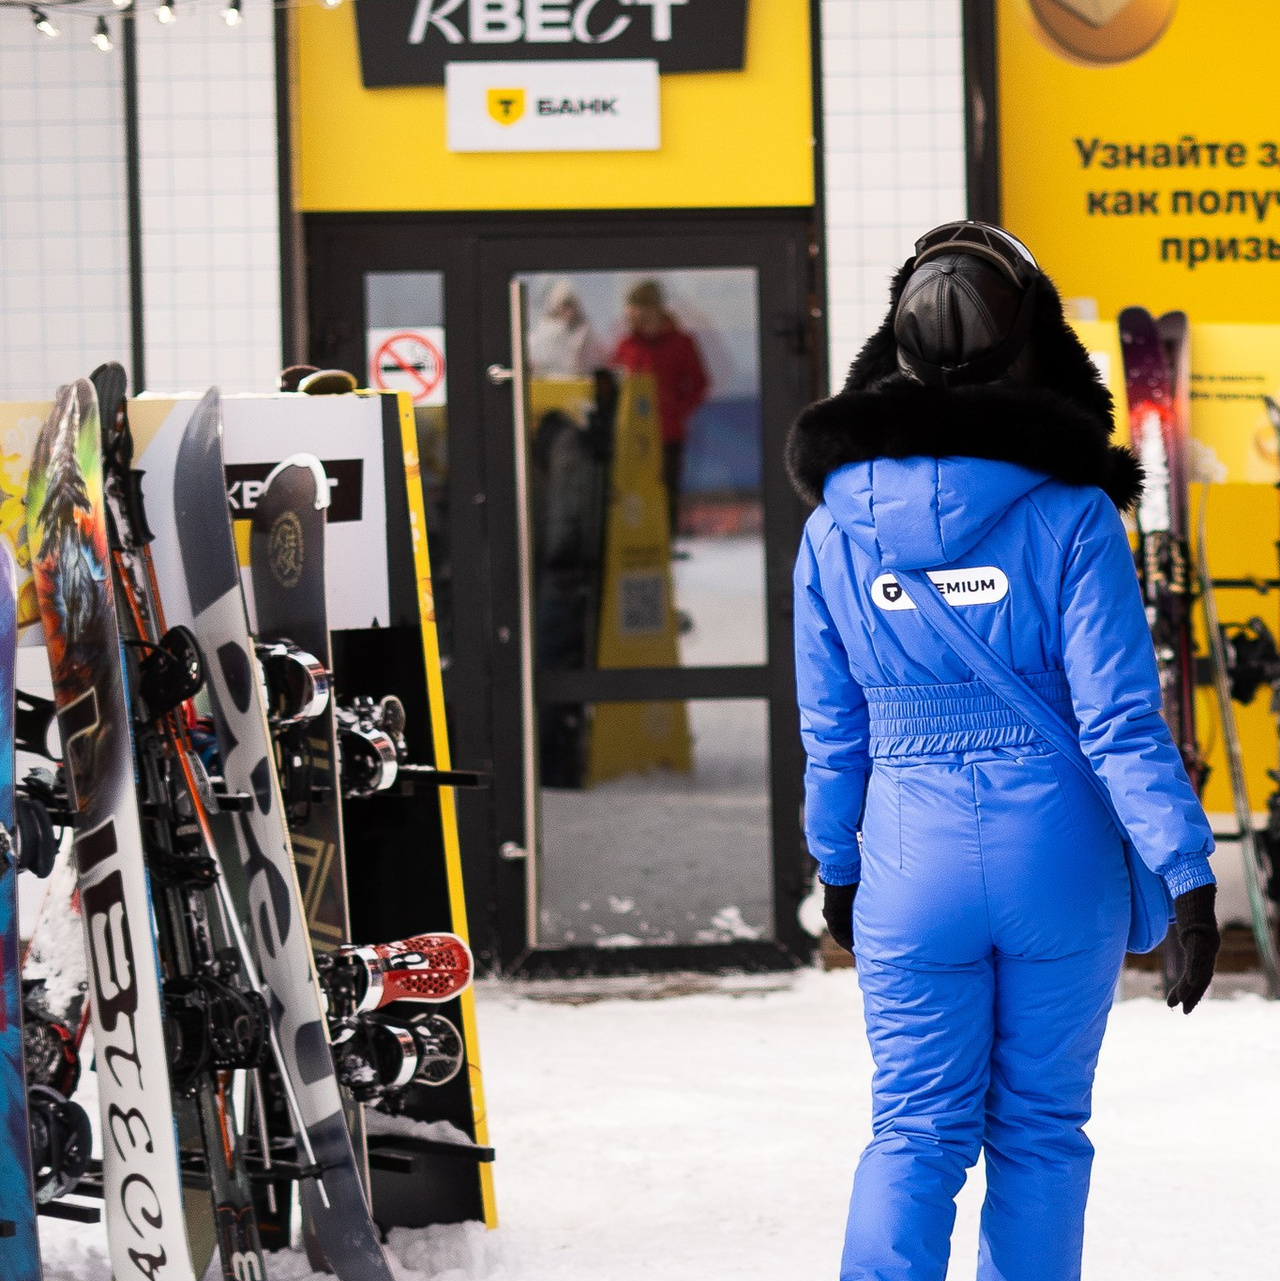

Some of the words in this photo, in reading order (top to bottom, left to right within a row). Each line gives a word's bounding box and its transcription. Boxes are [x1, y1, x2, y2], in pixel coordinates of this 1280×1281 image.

[537, 98, 618, 116] БАНК
[1073, 135, 1247, 169] Узнайте
[1087, 190, 1160, 216] как
